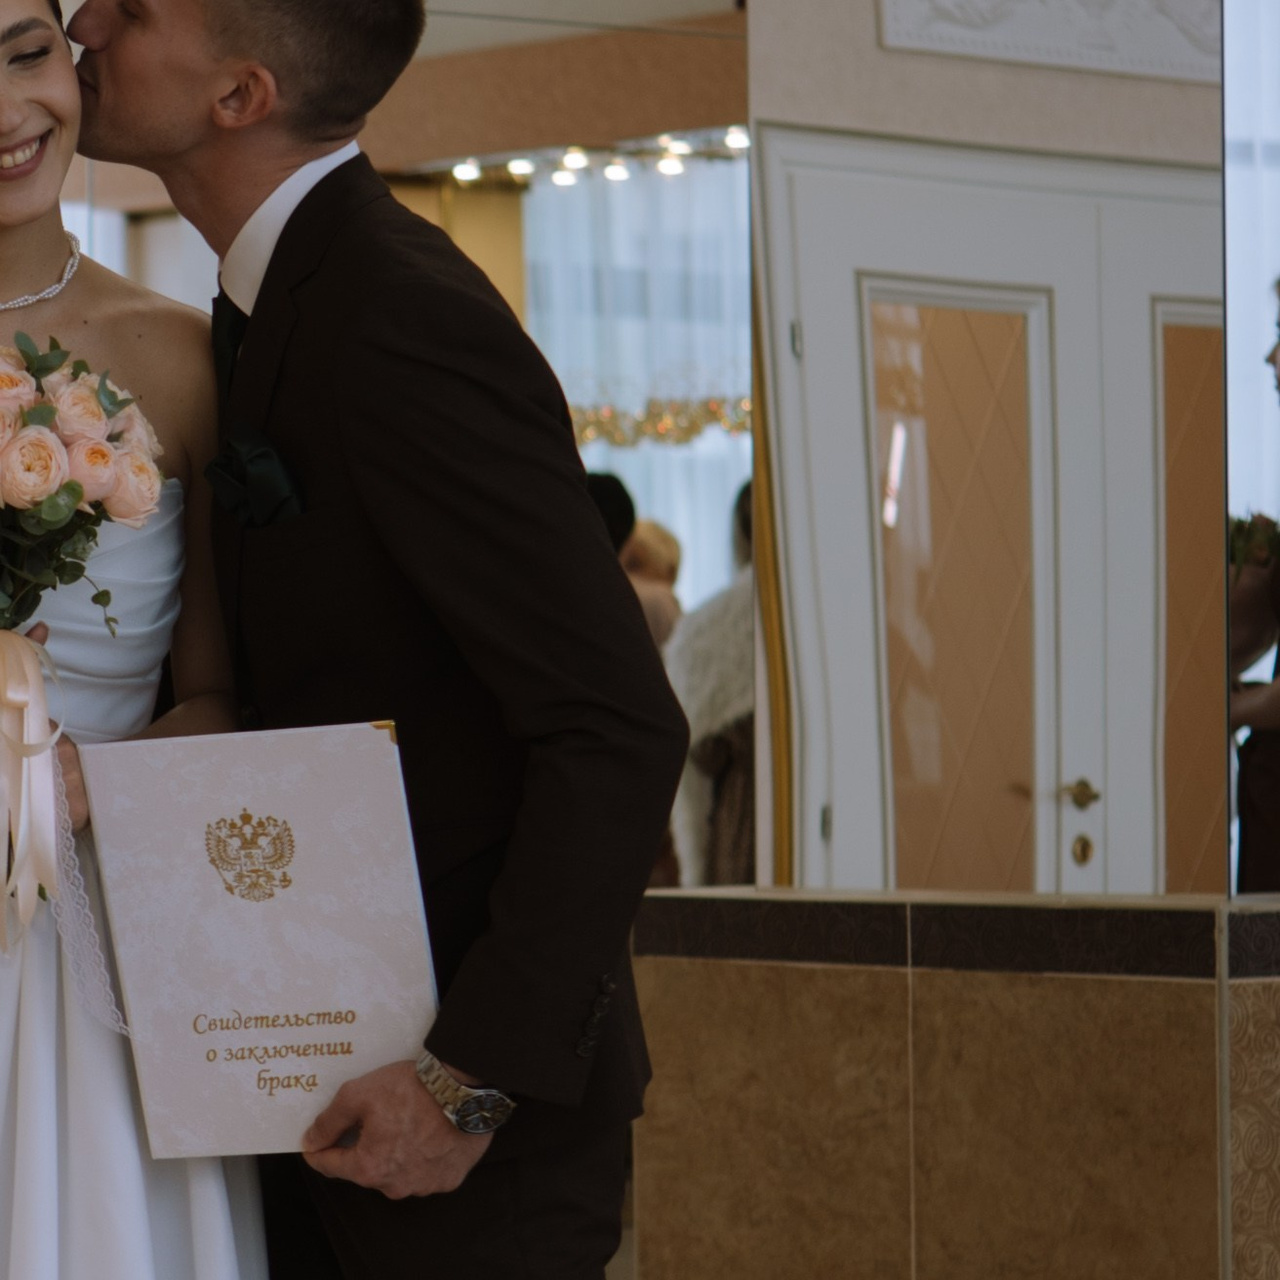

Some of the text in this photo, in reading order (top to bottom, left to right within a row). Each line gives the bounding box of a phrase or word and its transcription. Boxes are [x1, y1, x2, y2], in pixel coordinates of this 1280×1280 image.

[193, 1009, 356, 1034] Свидетельство
[206, 1041, 354, 1064] о заключении
[257, 1069, 318, 1096] брака
